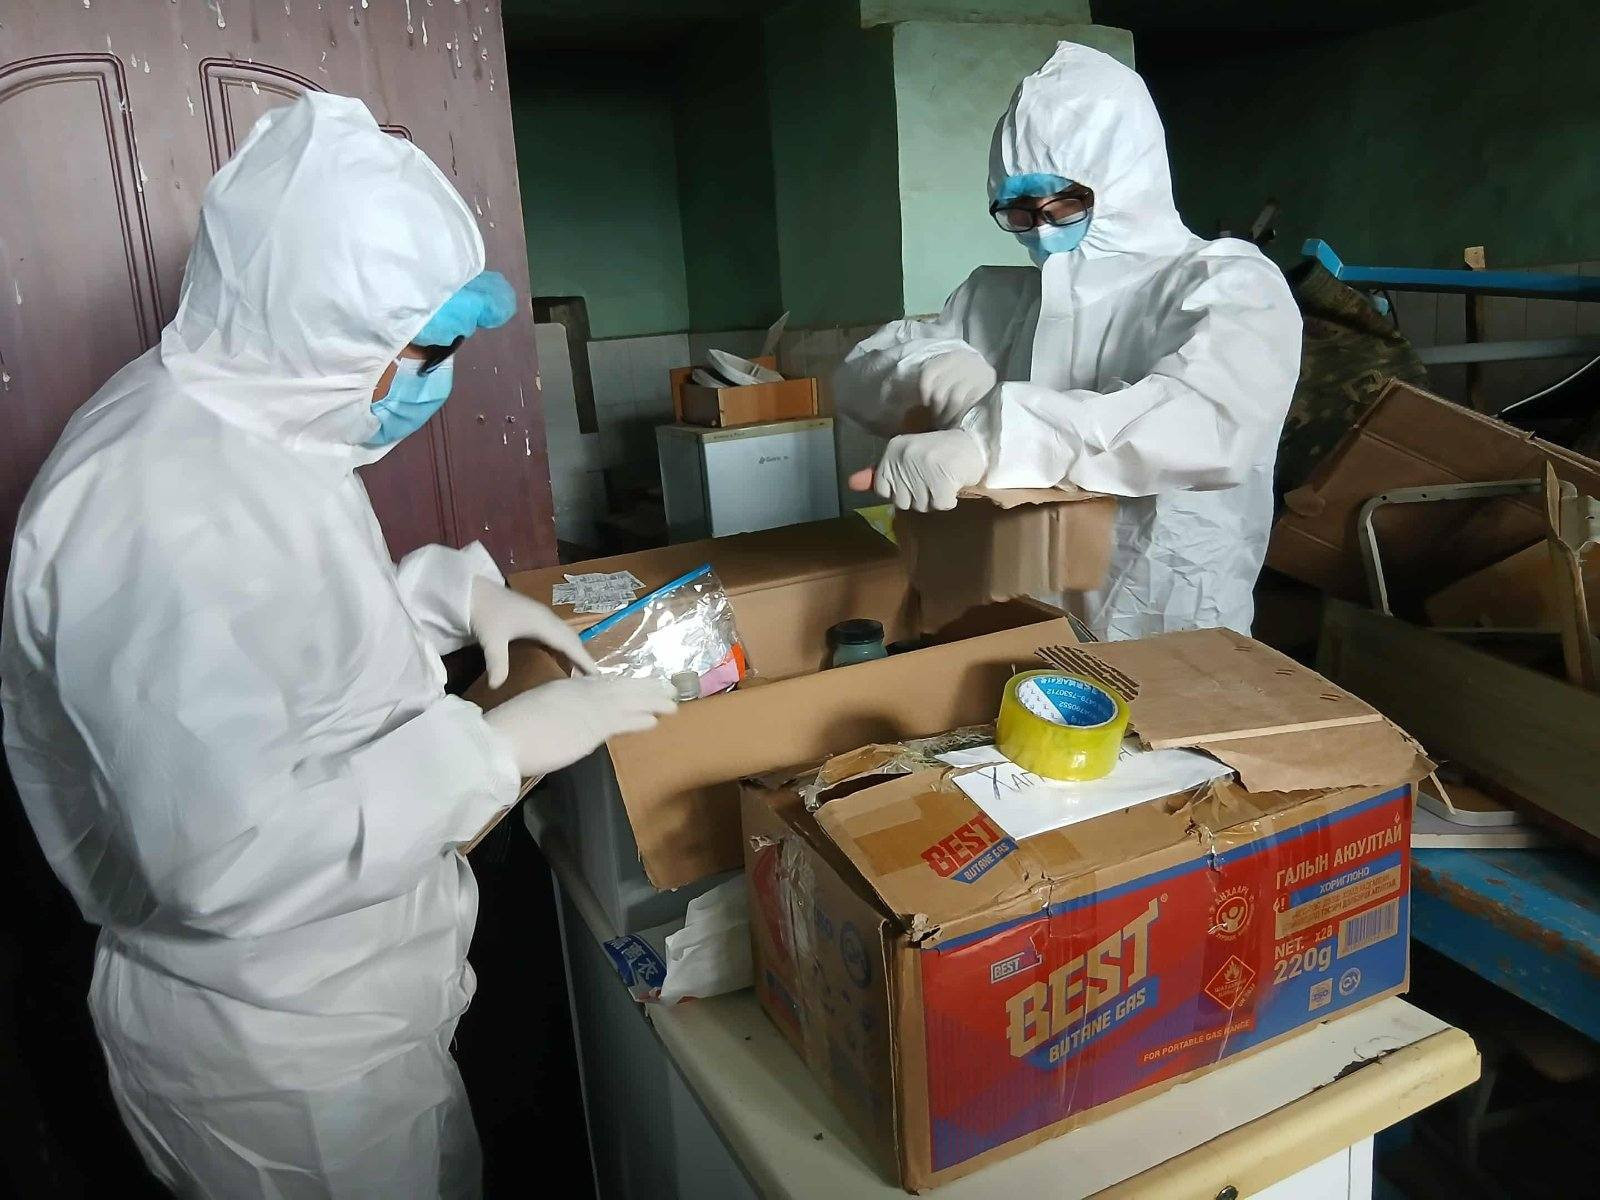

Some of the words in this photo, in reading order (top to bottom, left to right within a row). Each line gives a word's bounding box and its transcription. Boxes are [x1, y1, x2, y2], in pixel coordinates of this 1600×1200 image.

[921, 811, 1000, 878] BEST
[963, 853, 993, 880] BUTANE
[992, 842, 1010, 858] GAS
[1276, 853, 1329, 889] ГАЛЫН
[1333, 824, 1402, 867] АЮУЛТАЙ
[1320, 867, 1370, 894] ХОРИГЛОНО
[994, 957, 1020, 979] BEST
[1273, 945, 1332, 984] 220g
[1274, 936, 1304, 960] NET.
[1006, 898, 1159, 1058] BEST
[1049, 1010, 1111, 1064] BUTANE
[1115, 987, 1146, 1021] GAS
[1143, 1049, 1161, 1062] FOR
[1162, 1035, 1204, 1056] PORTABLE
[1205, 1029, 1222, 1041] GAS
[1223, 1019, 1251, 1036] RANGE
